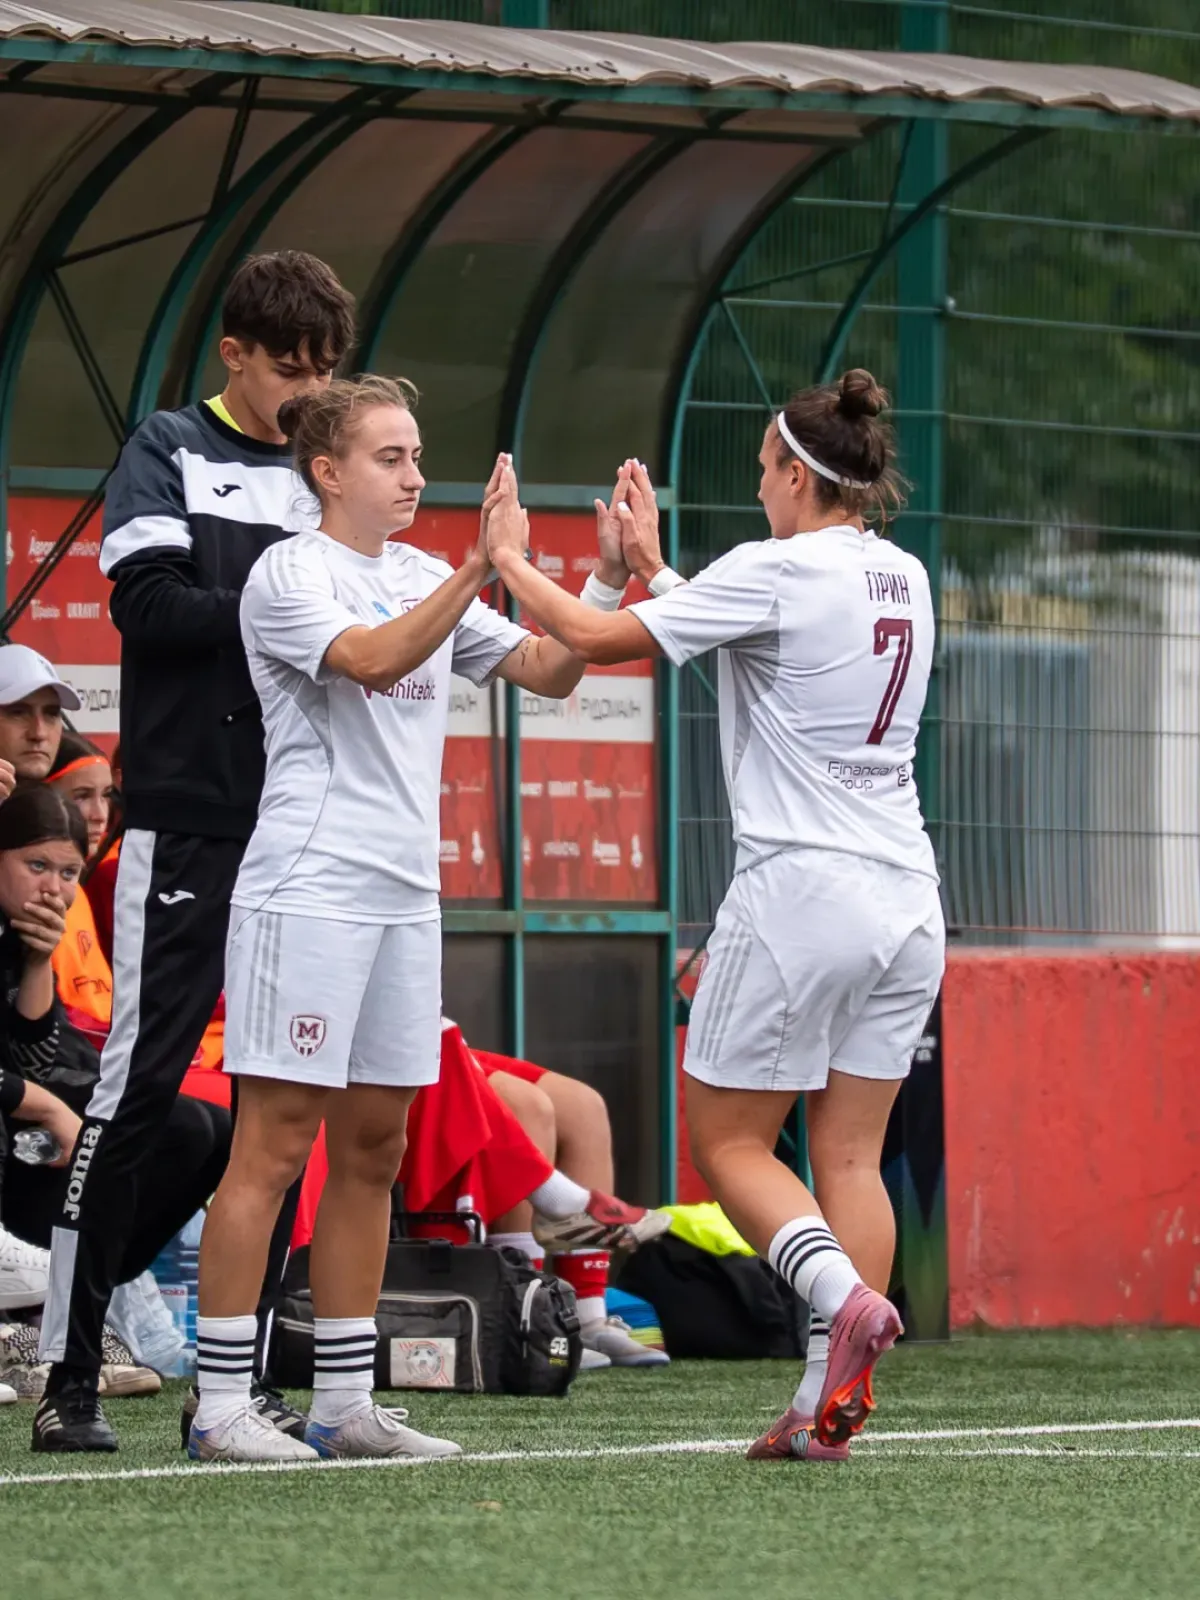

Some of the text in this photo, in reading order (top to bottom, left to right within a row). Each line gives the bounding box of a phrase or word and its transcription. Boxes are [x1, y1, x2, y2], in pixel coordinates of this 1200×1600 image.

[865, 570, 911, 605] ГІРИН
[865, 617, 914, 746] 7
[833, 776, 873, 792] roup
[296, 1021, 320, 1040] M
